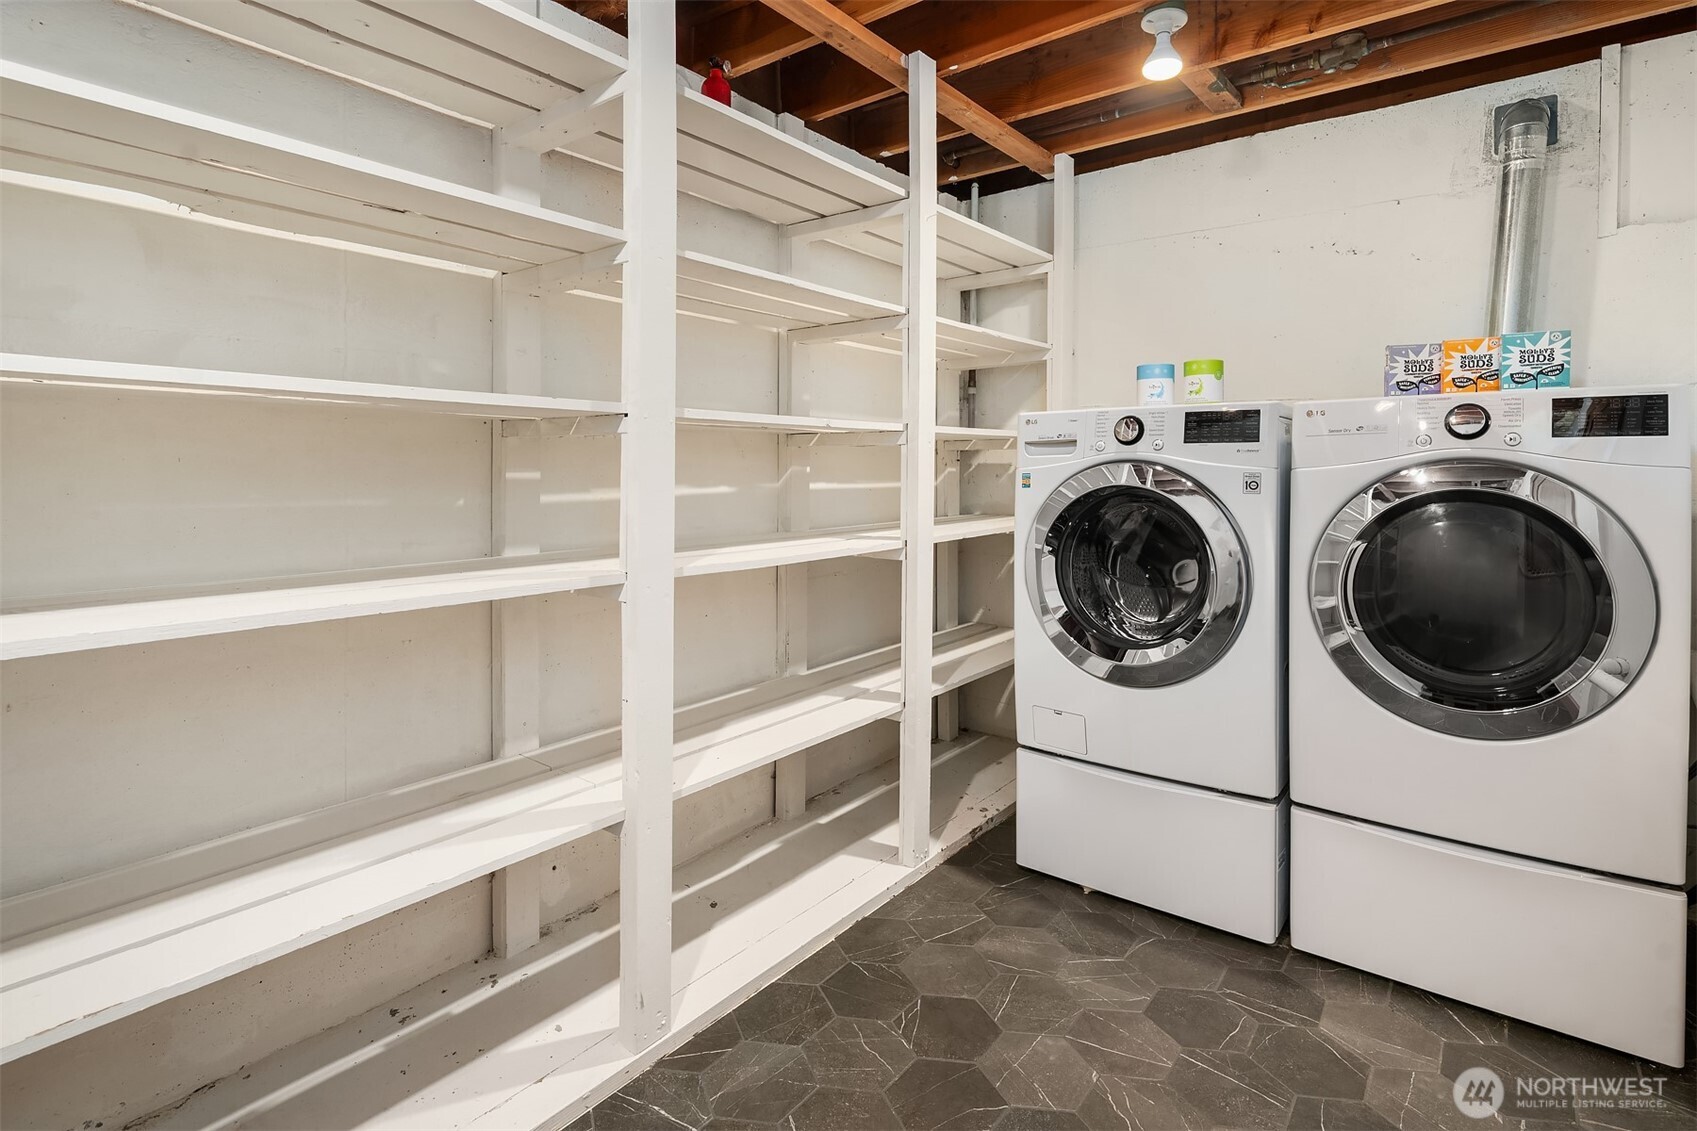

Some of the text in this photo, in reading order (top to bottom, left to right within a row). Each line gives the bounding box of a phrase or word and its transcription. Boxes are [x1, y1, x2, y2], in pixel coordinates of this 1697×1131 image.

[1518, 353, 1556, 364] SUDS
[1403, 364, 1434, 373] SUDS
[1459, 359, 1494, 369] SUDS
